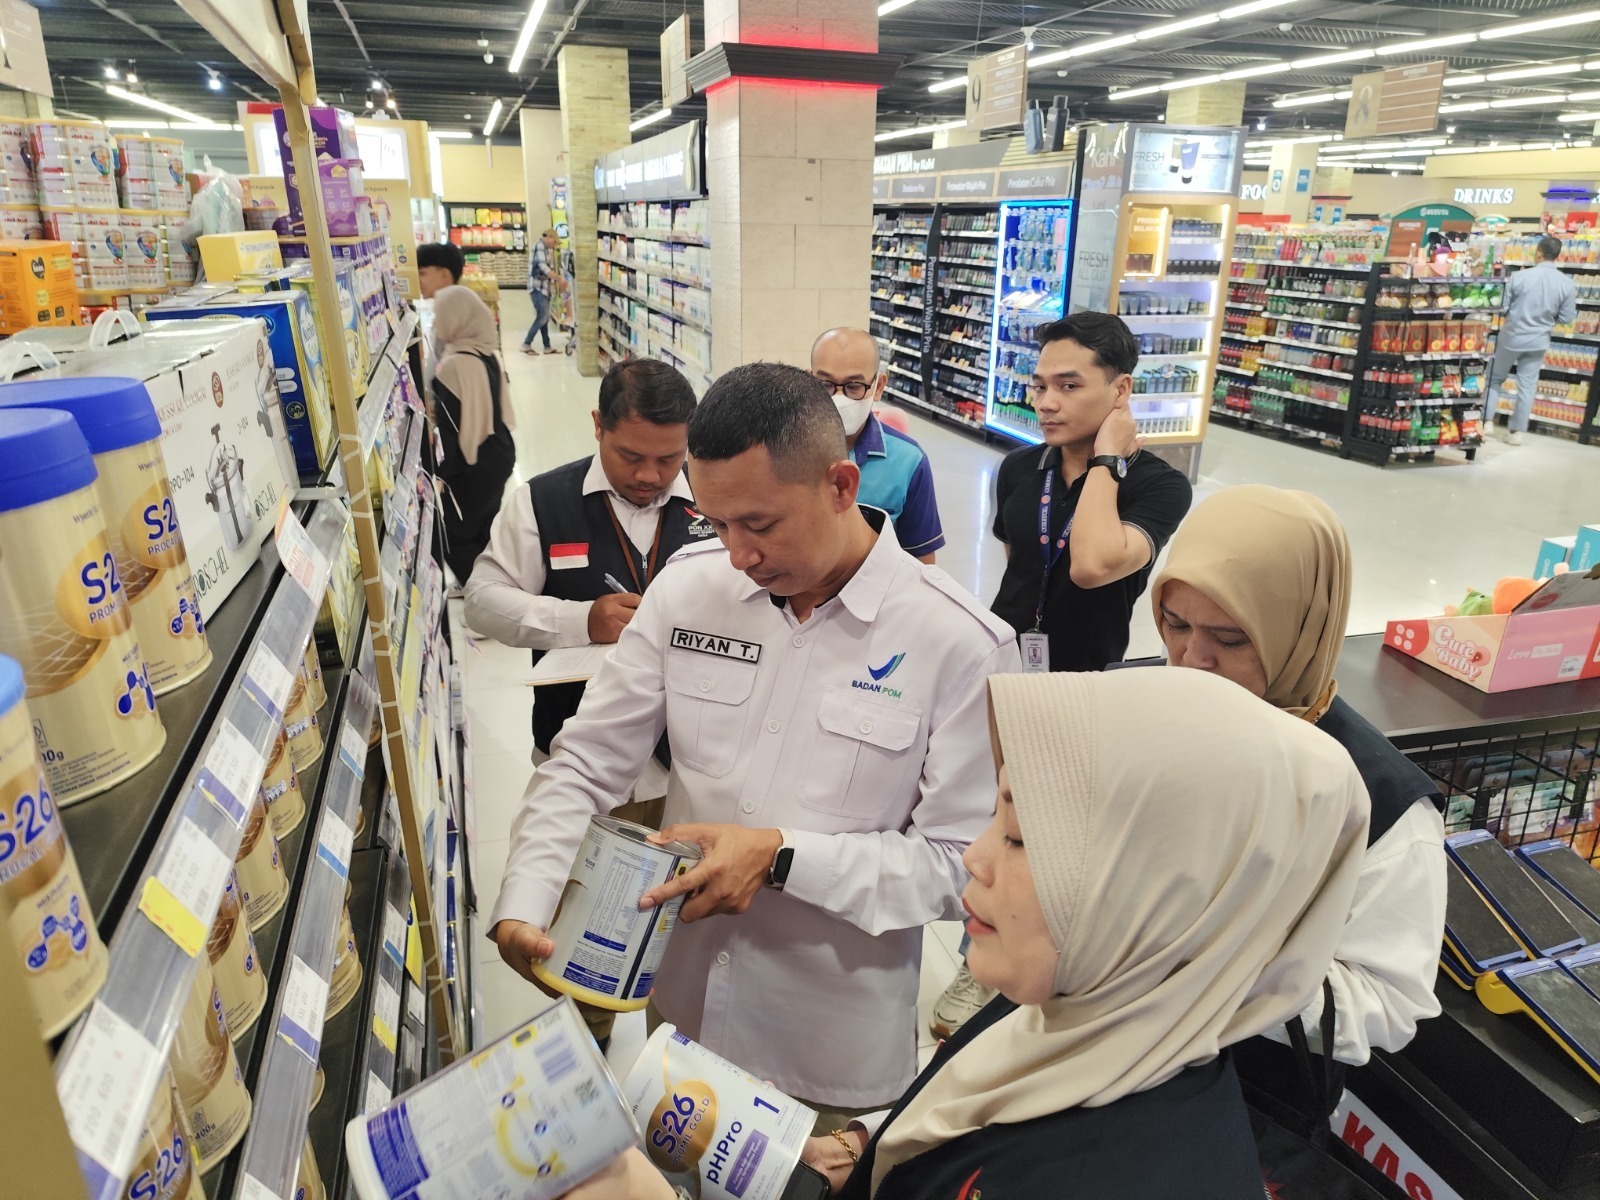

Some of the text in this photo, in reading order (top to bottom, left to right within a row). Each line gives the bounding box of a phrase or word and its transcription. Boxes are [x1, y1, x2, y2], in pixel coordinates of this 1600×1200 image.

[1454, 188, 1515, 204] DRINKS
[925, 256, 937, 306] Perawatan
[143, 497, 179, 540] S-2
[81, 552, 121, 605] S-2
[676, 632, 755, 659] RIYAN T.
[1433, 624, 1478, 657] Cute
[1435, 647, 1482, 682] Baby
[851, 680, 903, 699] BADAN POM
[652, 1092, 696, 1155] S-26
[753, 1096, 781, 1114] 1
[671, 1097, 711, 1167] PROMIL GOLD
[705, 1120, 744, 1185] pHPro
